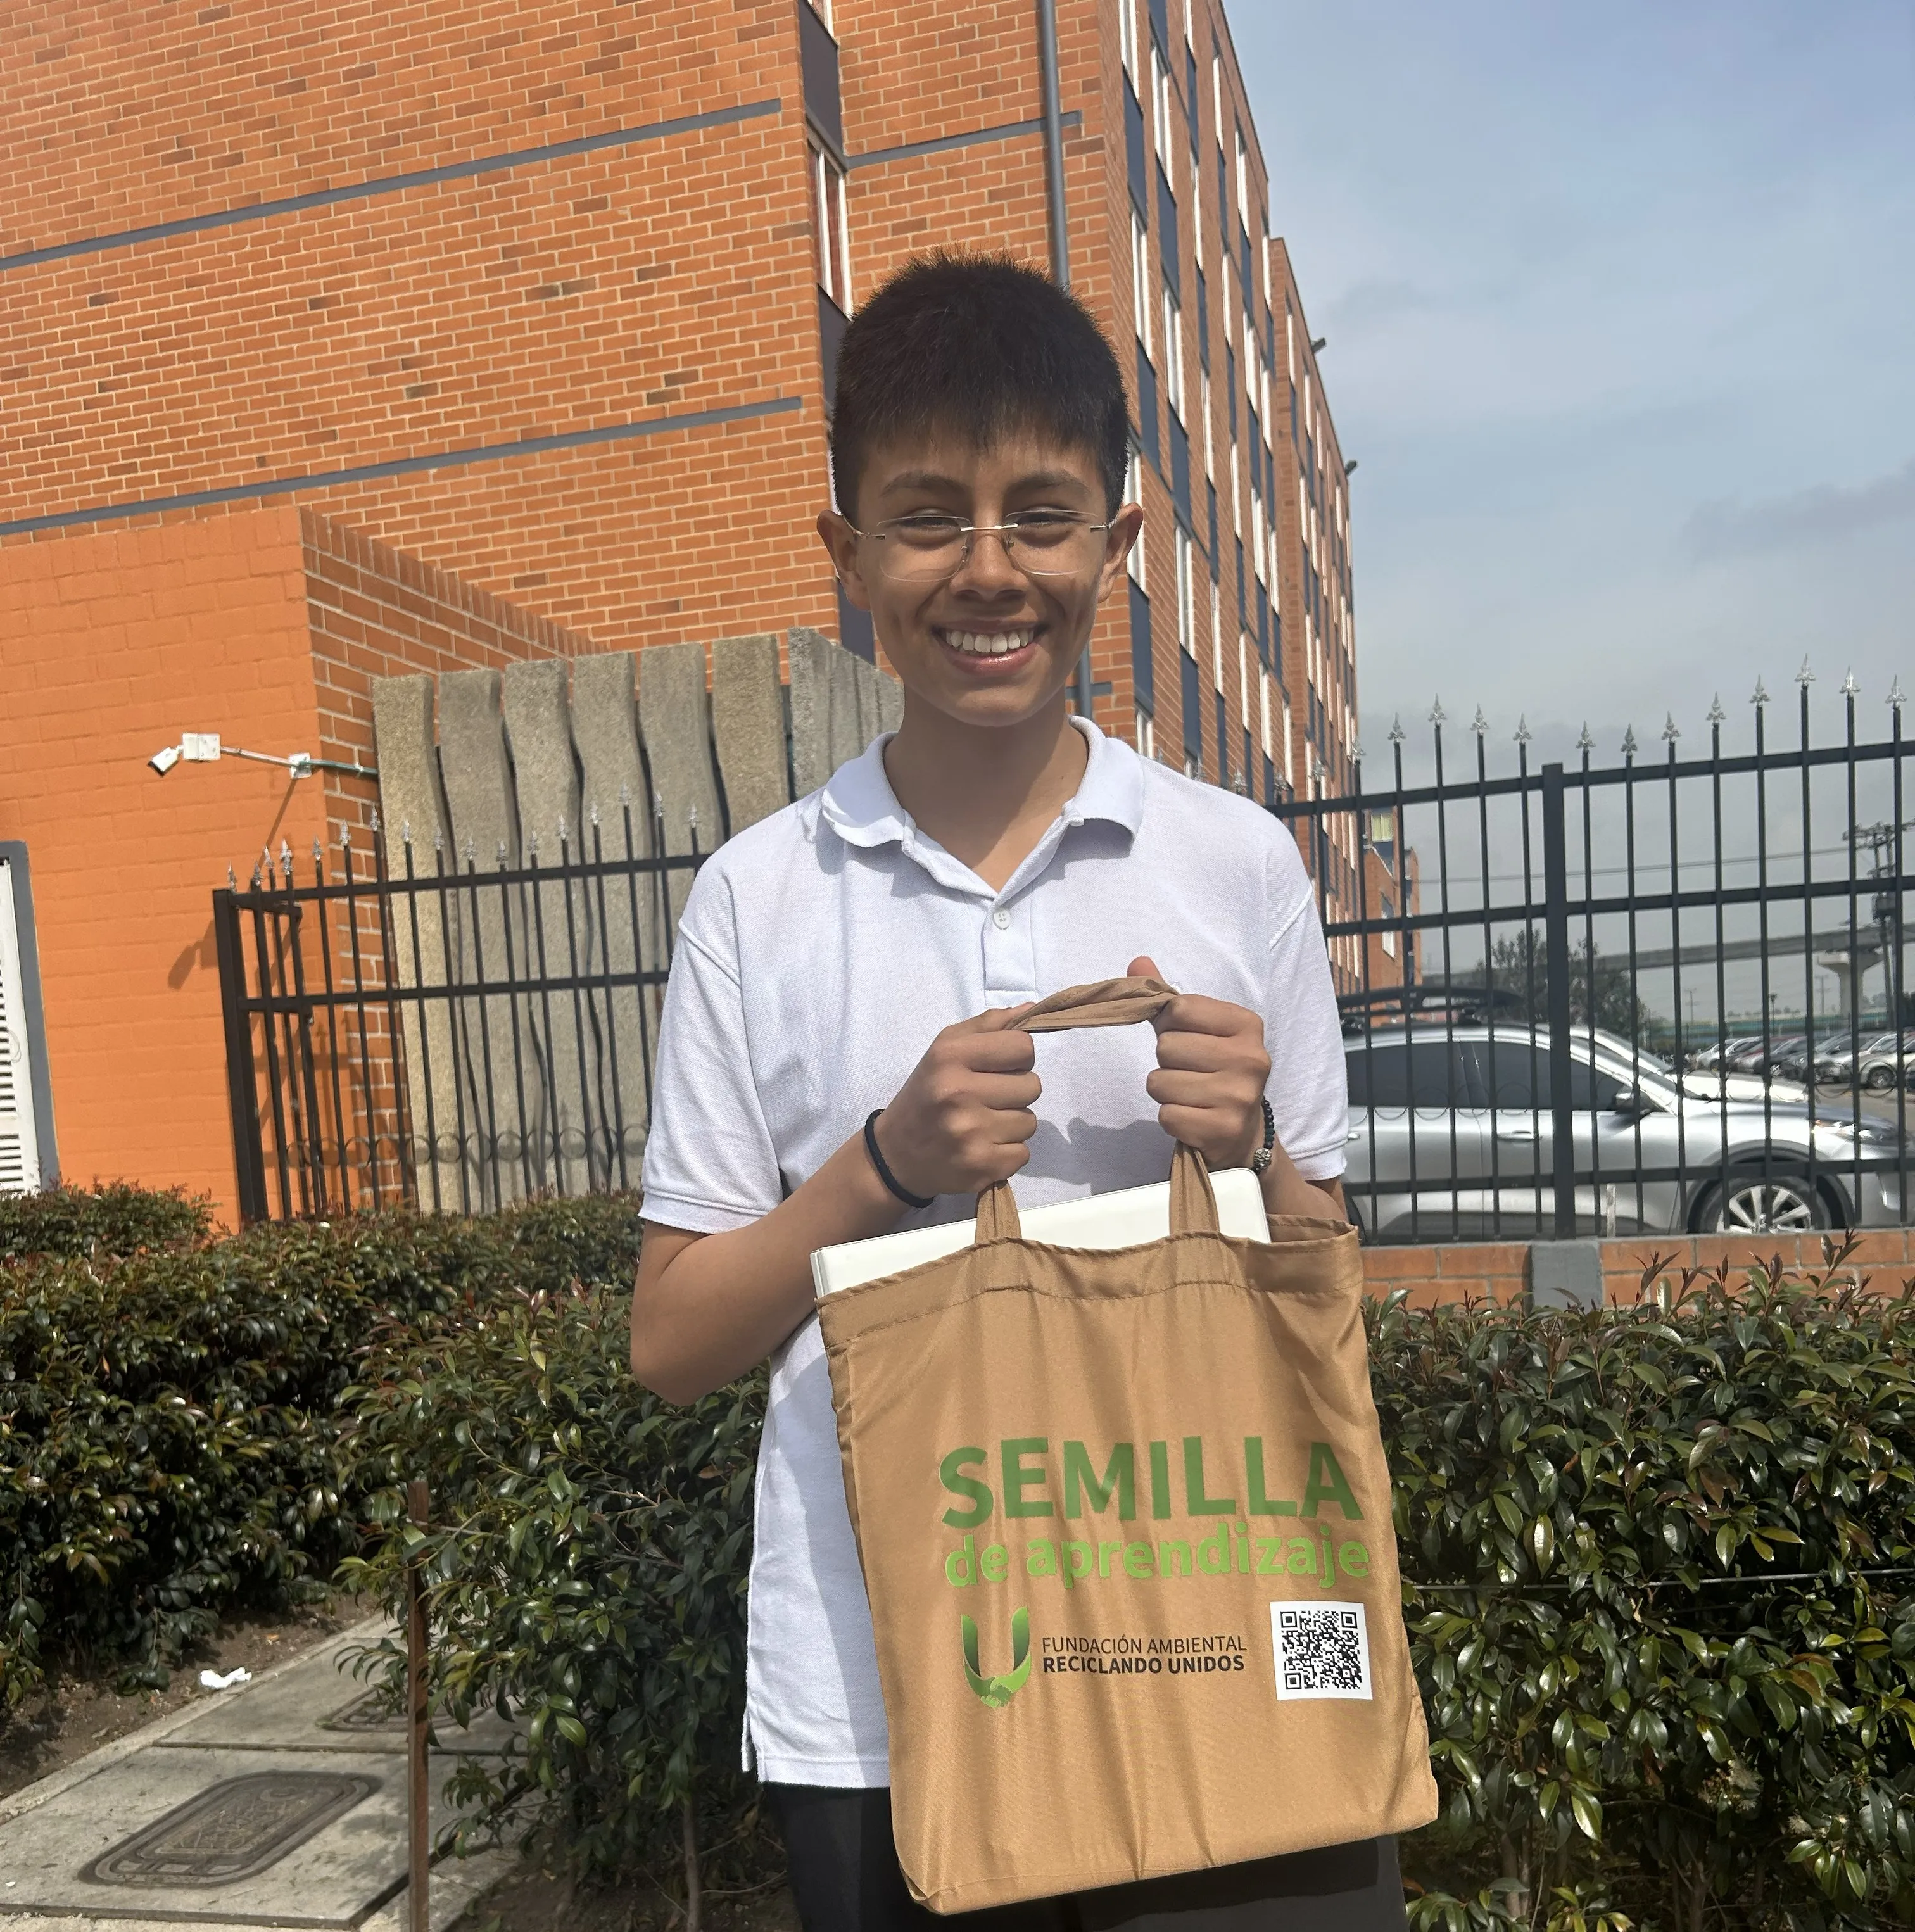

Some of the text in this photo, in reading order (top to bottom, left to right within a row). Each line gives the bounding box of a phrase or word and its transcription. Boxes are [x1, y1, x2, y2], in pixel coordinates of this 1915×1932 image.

[939, 1436, 1364, 1529] SEMILLA
[944, 1522, 1370, 1588] de aprendizaje
[1042, 1634, 1248, 1655] FUNDACIÓN AMBIENTAL
[1043, 1655, 1244, 1674] RECICLANDO UNIDOS
